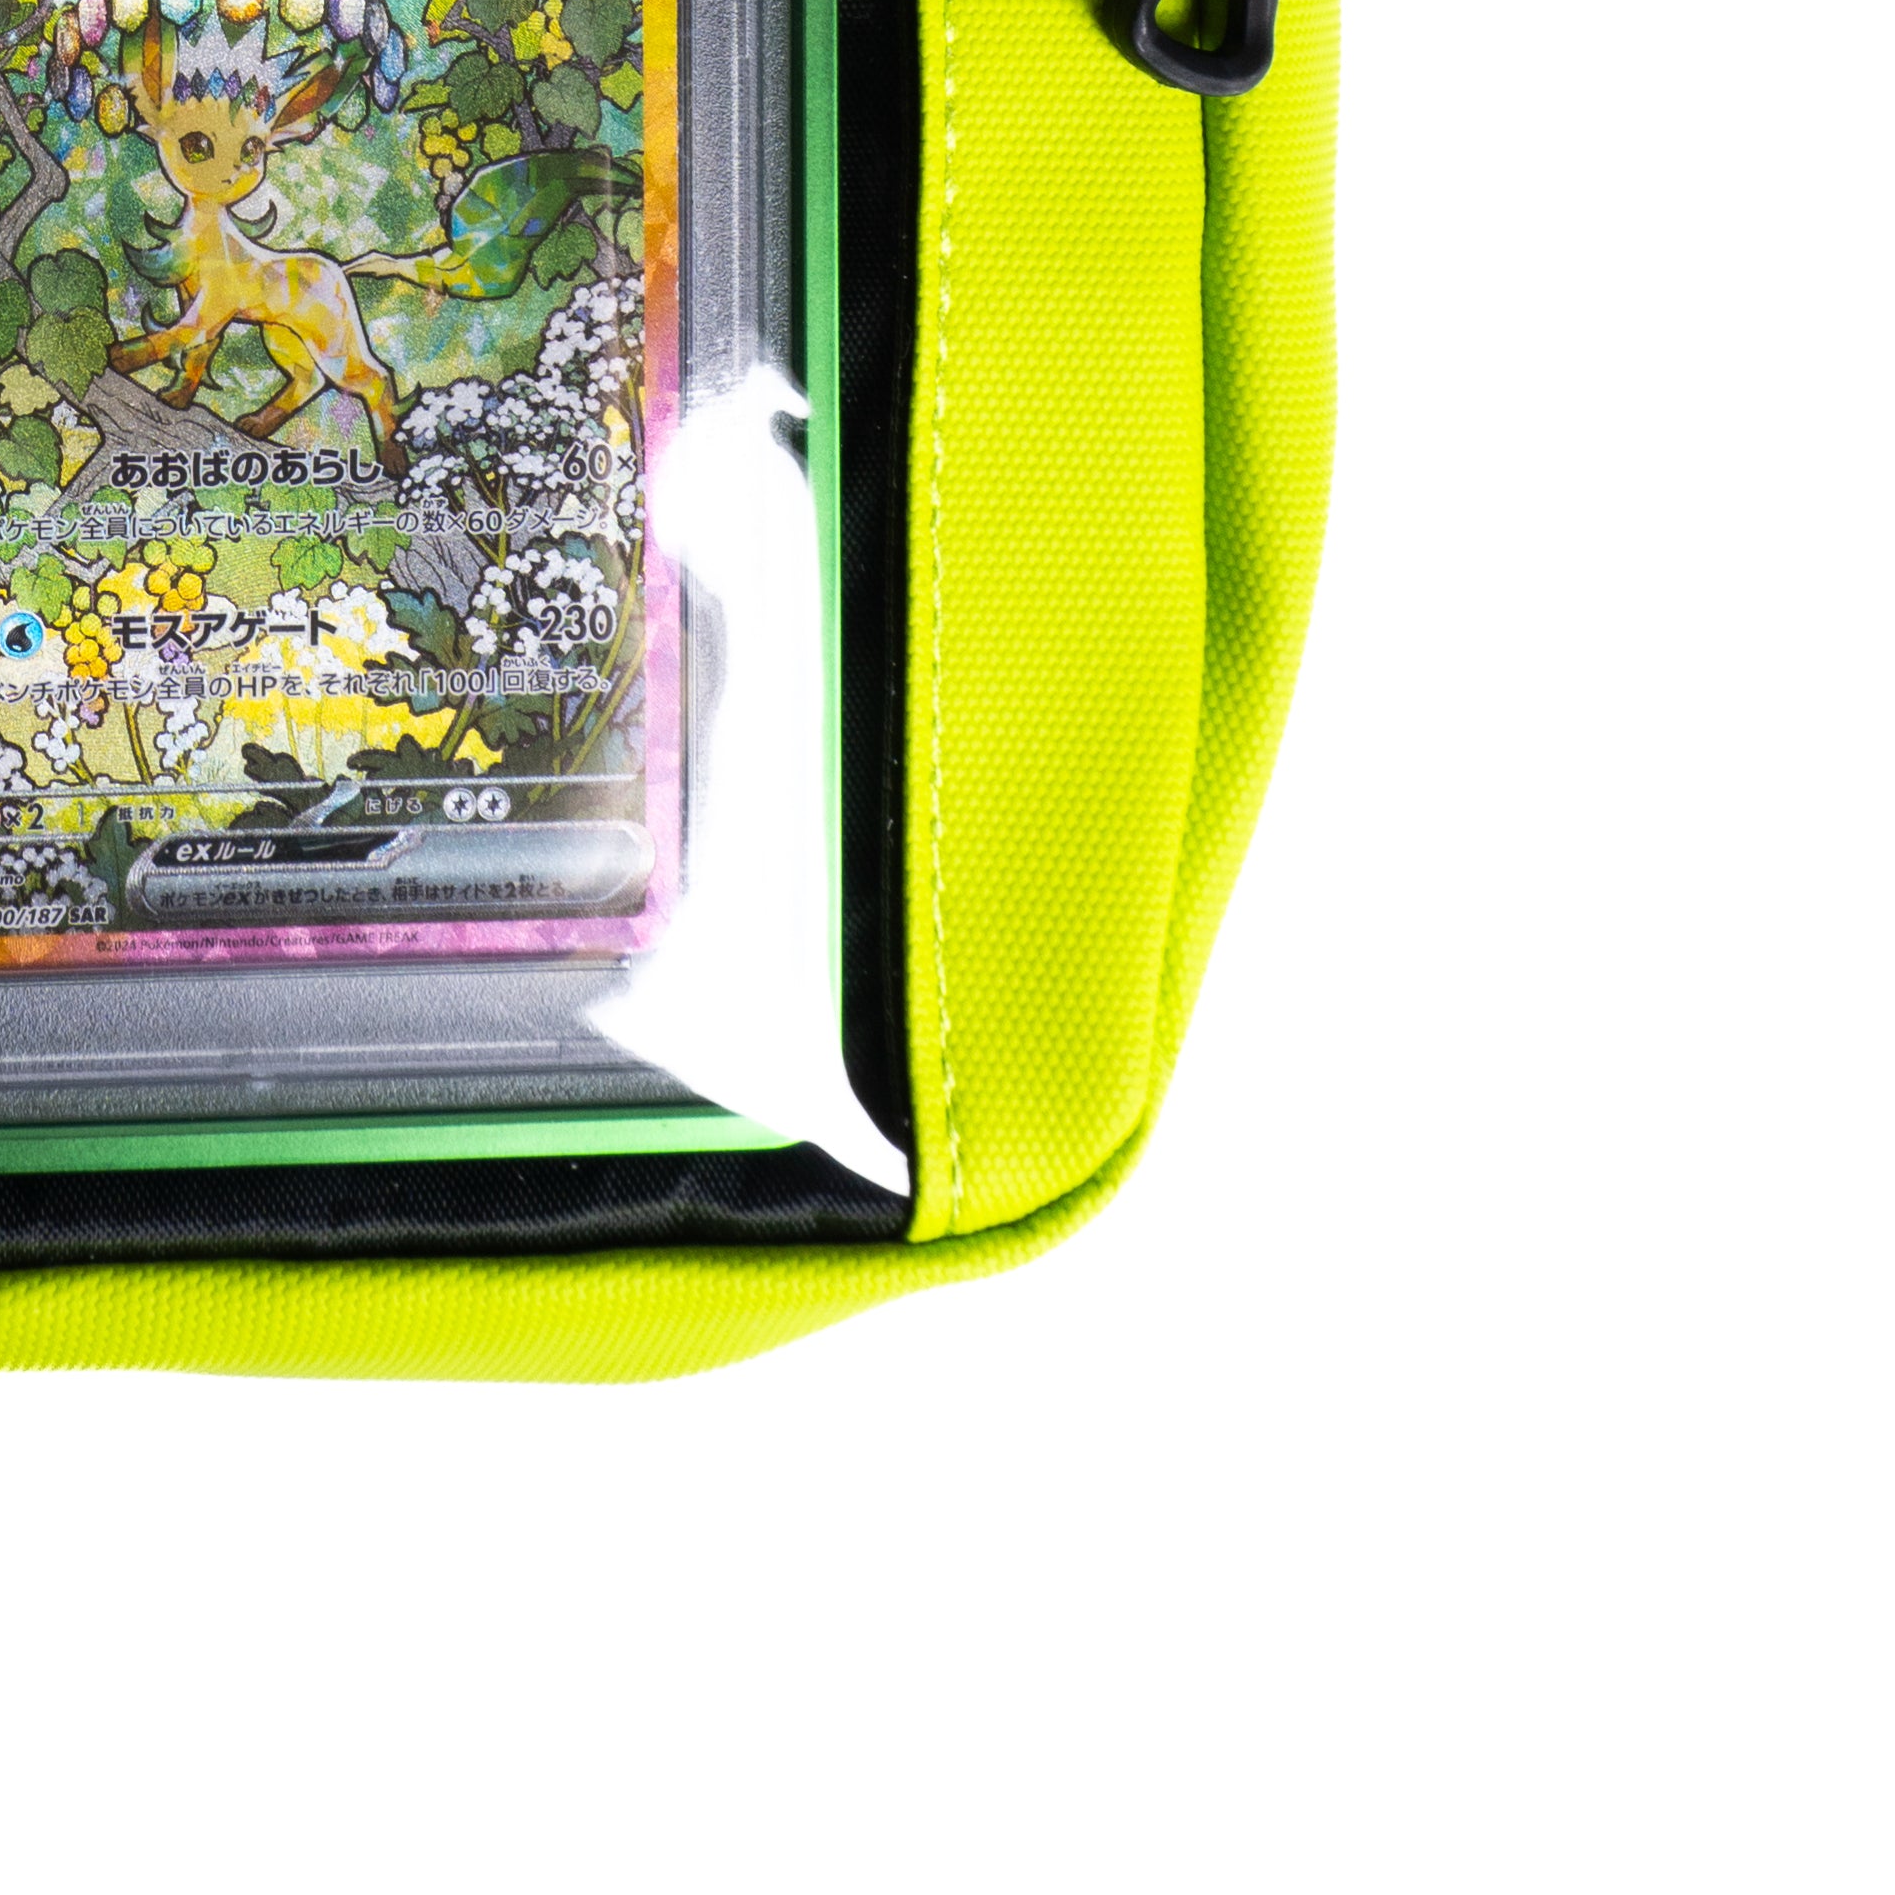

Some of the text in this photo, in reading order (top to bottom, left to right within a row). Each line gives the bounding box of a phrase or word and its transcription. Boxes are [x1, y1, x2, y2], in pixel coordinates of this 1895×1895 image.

[110, 448, 384, 490] あおばのあらし
[111, 611, 337, 651] モスアゲート
[539, 604, 617, 643] 230
[69, 907, 107, 924] SAR
